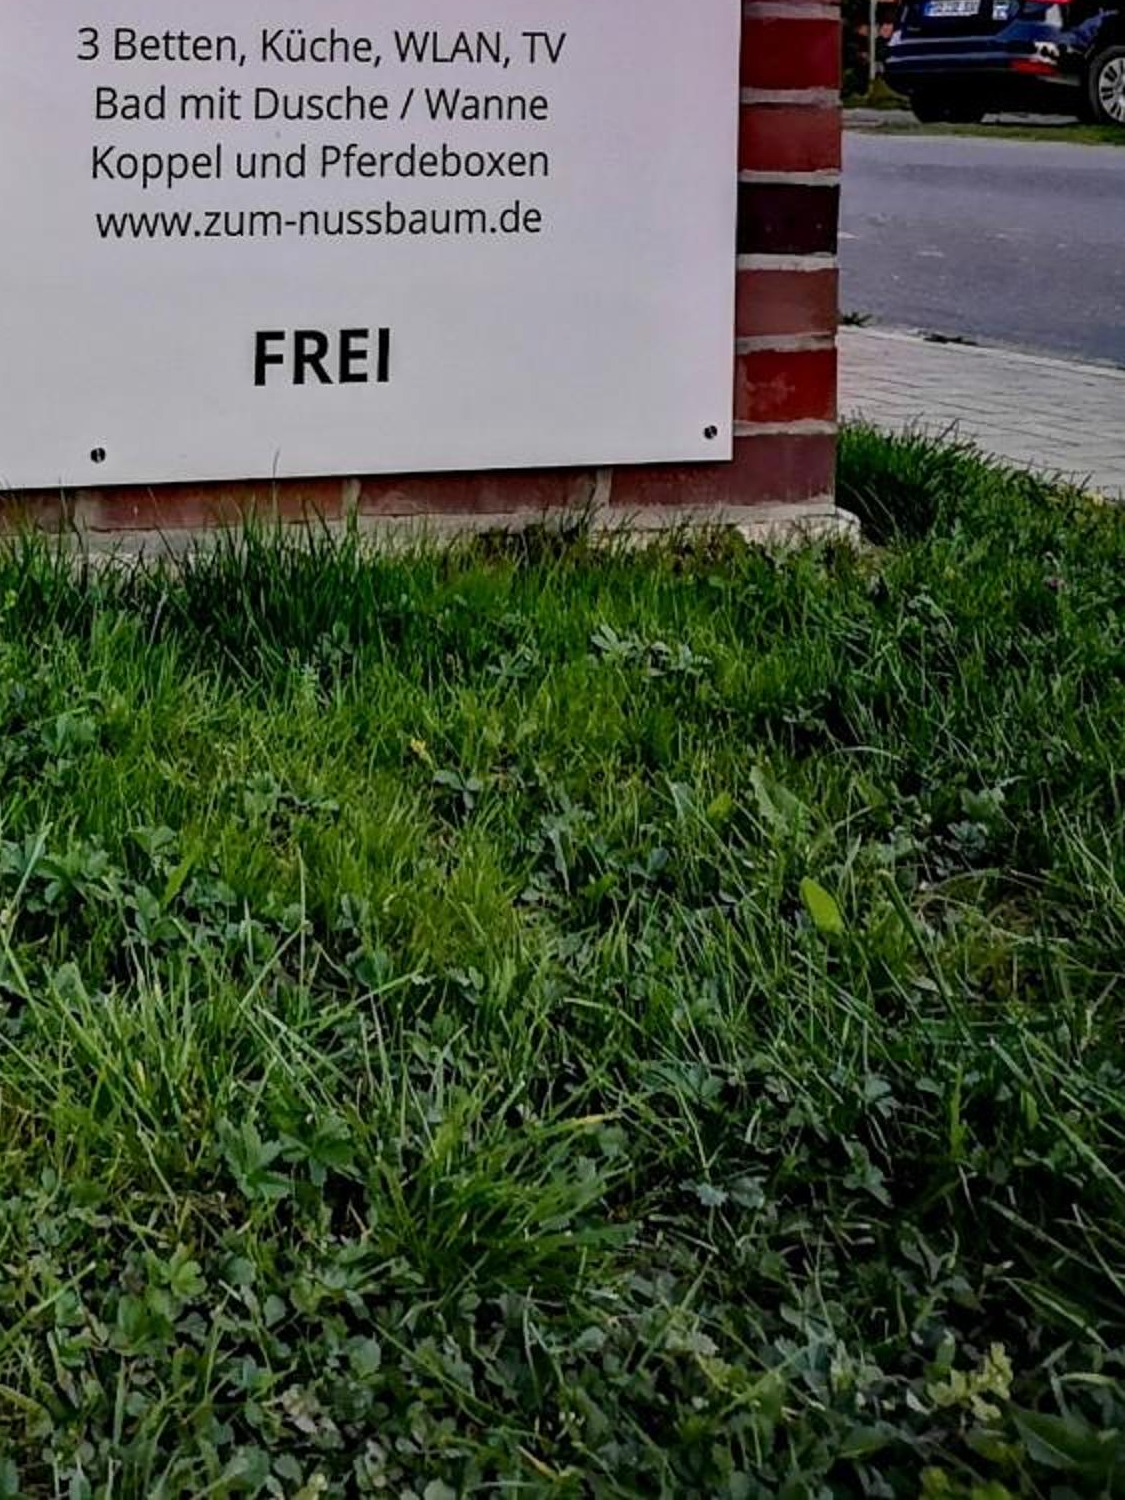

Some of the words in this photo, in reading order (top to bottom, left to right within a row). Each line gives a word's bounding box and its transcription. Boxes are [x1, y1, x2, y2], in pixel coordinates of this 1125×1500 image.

[77, 27, 99, 60] 3
[115, 28, 246, 67] Betten,
[262, 28, 381, 68] Küche,
[394, 30, 510, 68] WLAN,
[522, 32, 566, 64] TV
[96, 85, 165, 120] Bad
[181, 86, 241, 120] mit
[255, 86, 388, 120] Dusche
[425, 88, 548, 120] Wanne
[92, 143, 221, 189] Koppel
[237, 144, 306, 178] und
[321, 143, 548, 178] Pferdeboxen
[96, 200, 541, 238] www.zum-nussbaum.de
[254, 328, 390, 386] FREI
